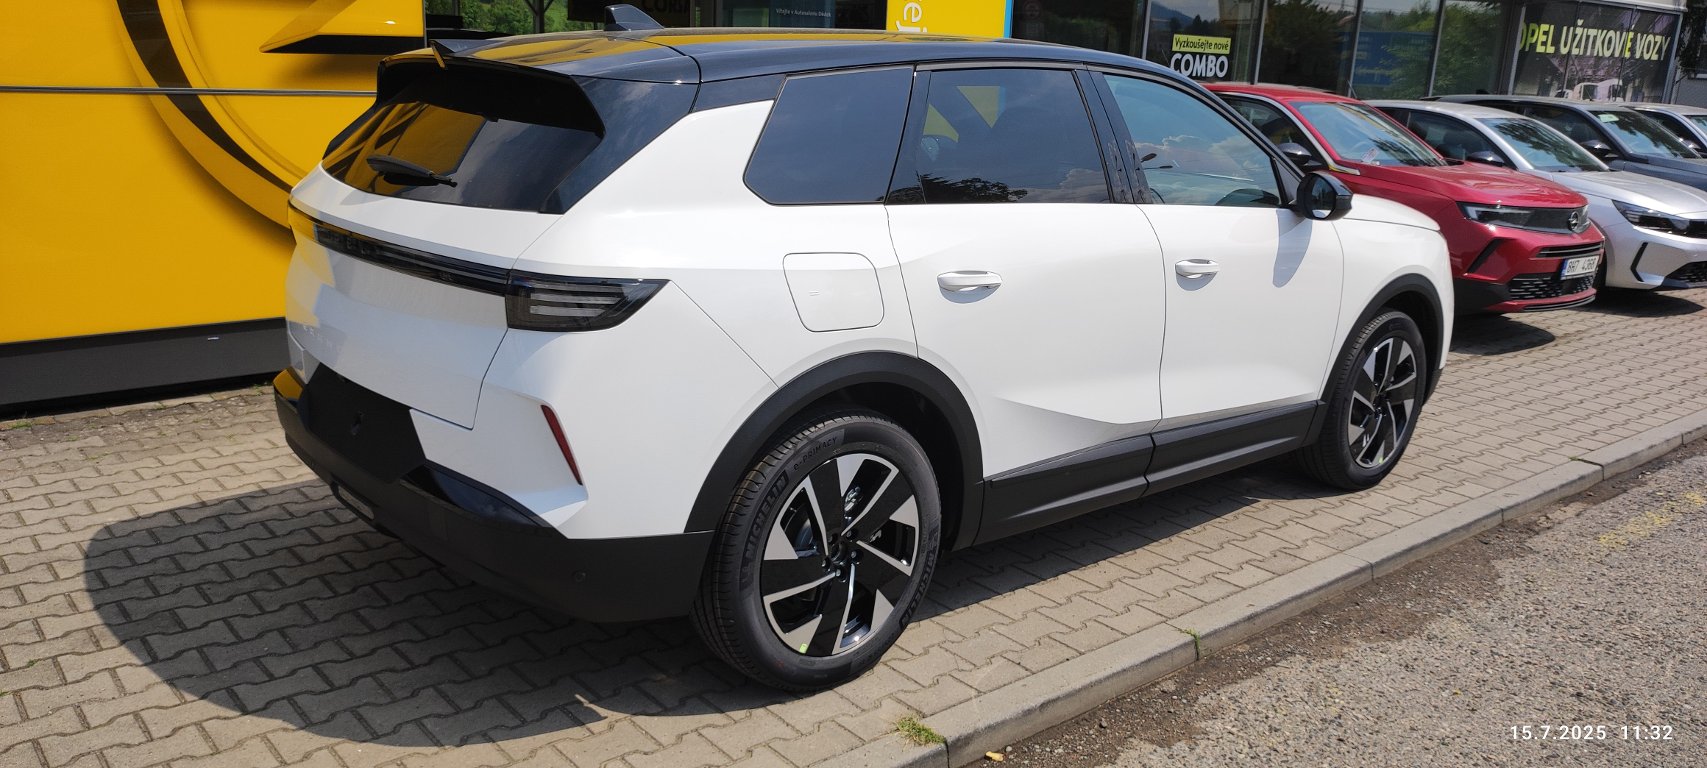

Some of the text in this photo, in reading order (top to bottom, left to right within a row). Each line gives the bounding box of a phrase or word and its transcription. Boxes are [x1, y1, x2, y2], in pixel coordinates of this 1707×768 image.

[1175, 37, 1229, 51] Vyzkoušejte nové
[1560, 19, 1635, 59] UŽITKOVÉ
[1636, 32, 1671, 61] VOZY
[1170, 52, 1229, 78] COMBO
